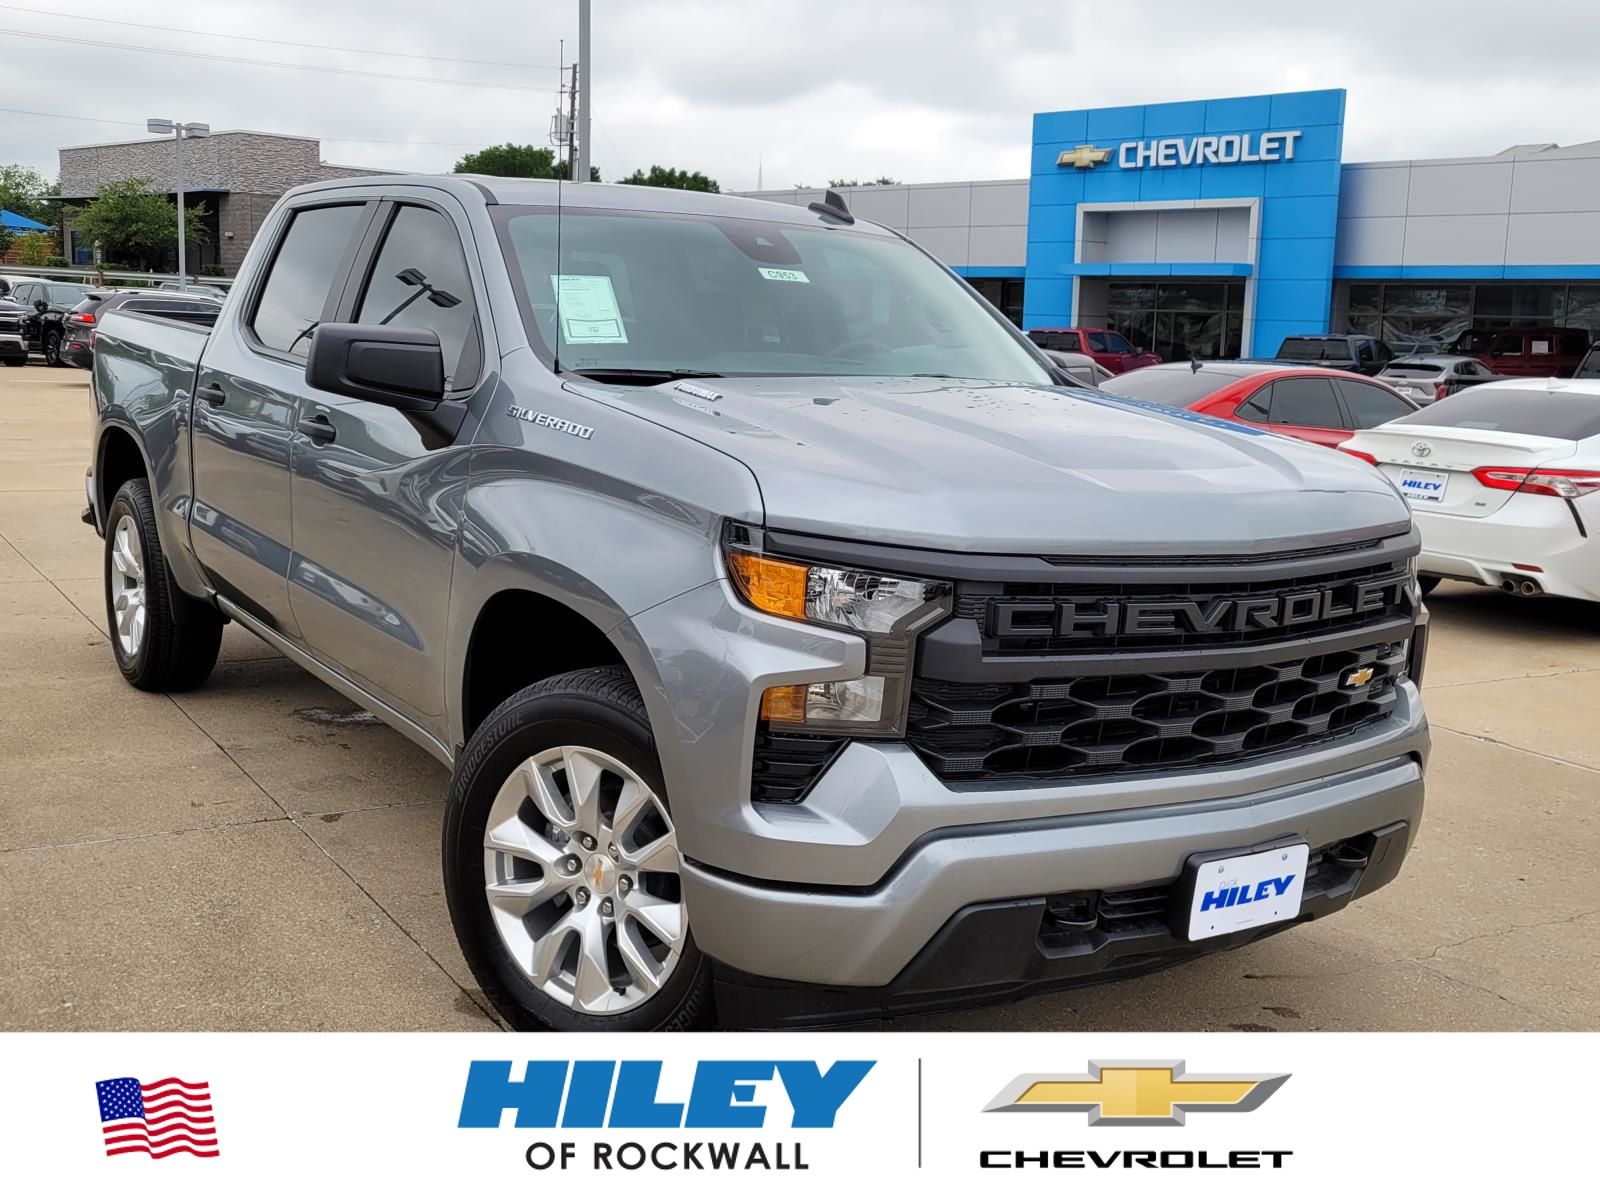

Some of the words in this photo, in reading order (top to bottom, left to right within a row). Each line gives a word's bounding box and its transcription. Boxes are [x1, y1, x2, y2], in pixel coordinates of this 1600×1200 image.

[1118, 131, 1301, 169] CHEVROLET
[767, 269, 798, 281] C953
[507, 404, 594, 441] SILVERADO
[1402, 479, 1442, 491] HILEY
[991, 574, 1411, 636] CHEVROLET
[454, 711, 524, 803] BRIDGESTONE
[1200, 874, 1297, 912] HILEY
